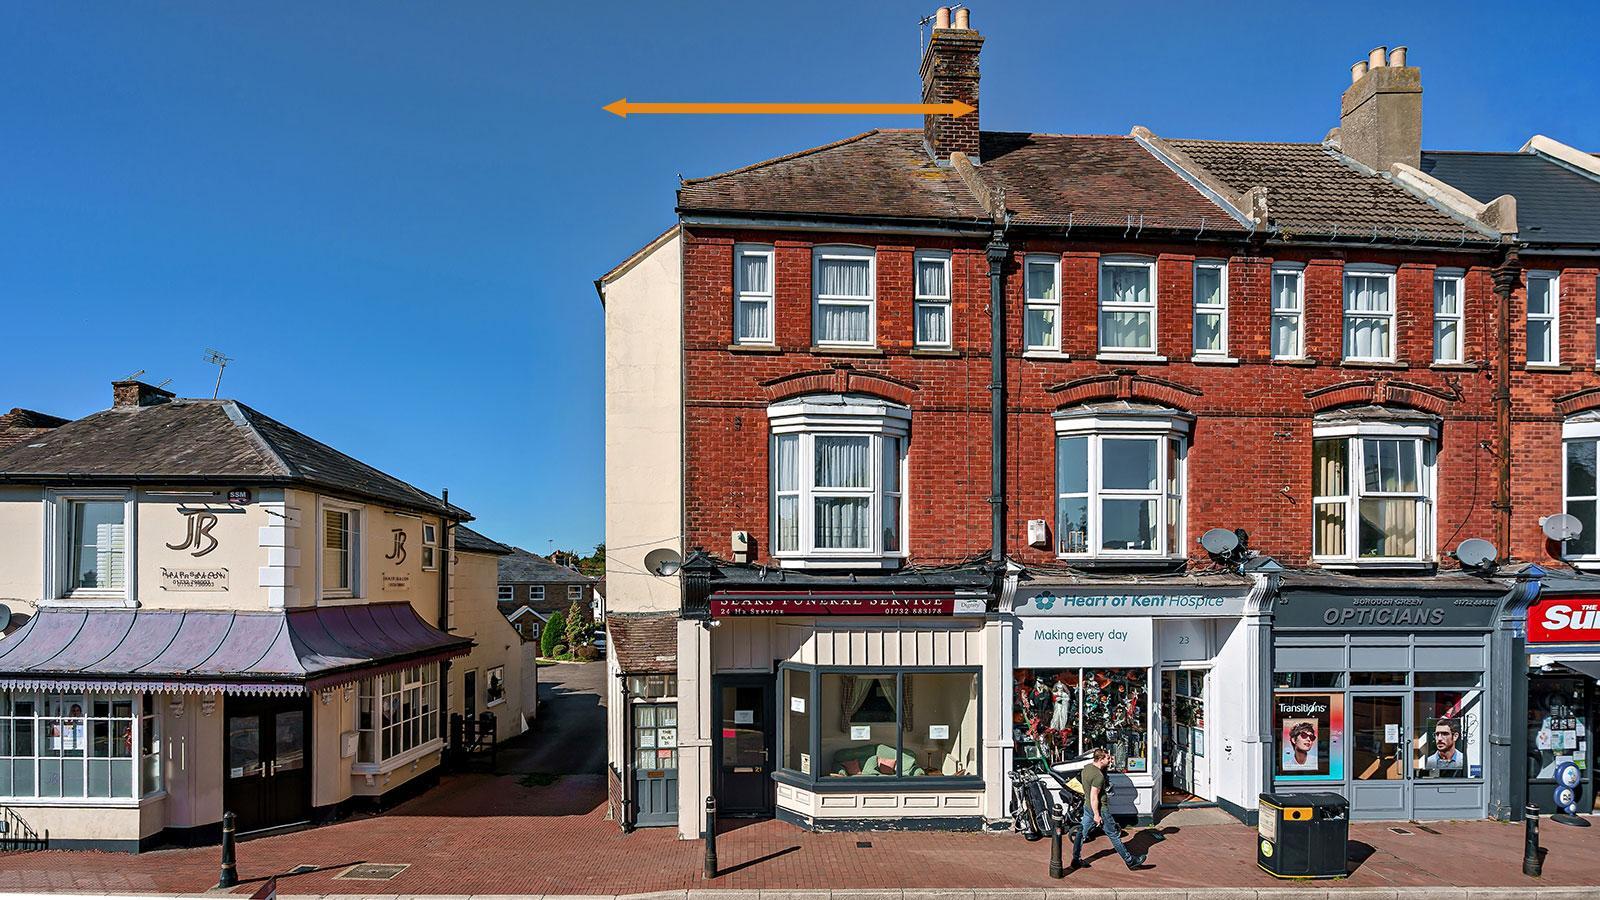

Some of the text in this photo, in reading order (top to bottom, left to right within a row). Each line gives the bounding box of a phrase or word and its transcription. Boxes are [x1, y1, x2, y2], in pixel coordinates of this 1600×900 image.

[1063, 594, 1224, 610] Heart of Kent Hospice
[1322, 607, 1445, 625] OPTICIANS
[1034, 629, 1128, 643] Making every day
[1178, 636, 1190, 645] 23
[1058, 643, 1104, 657] precious
[1278, 702, 1326, 716] Transitions
